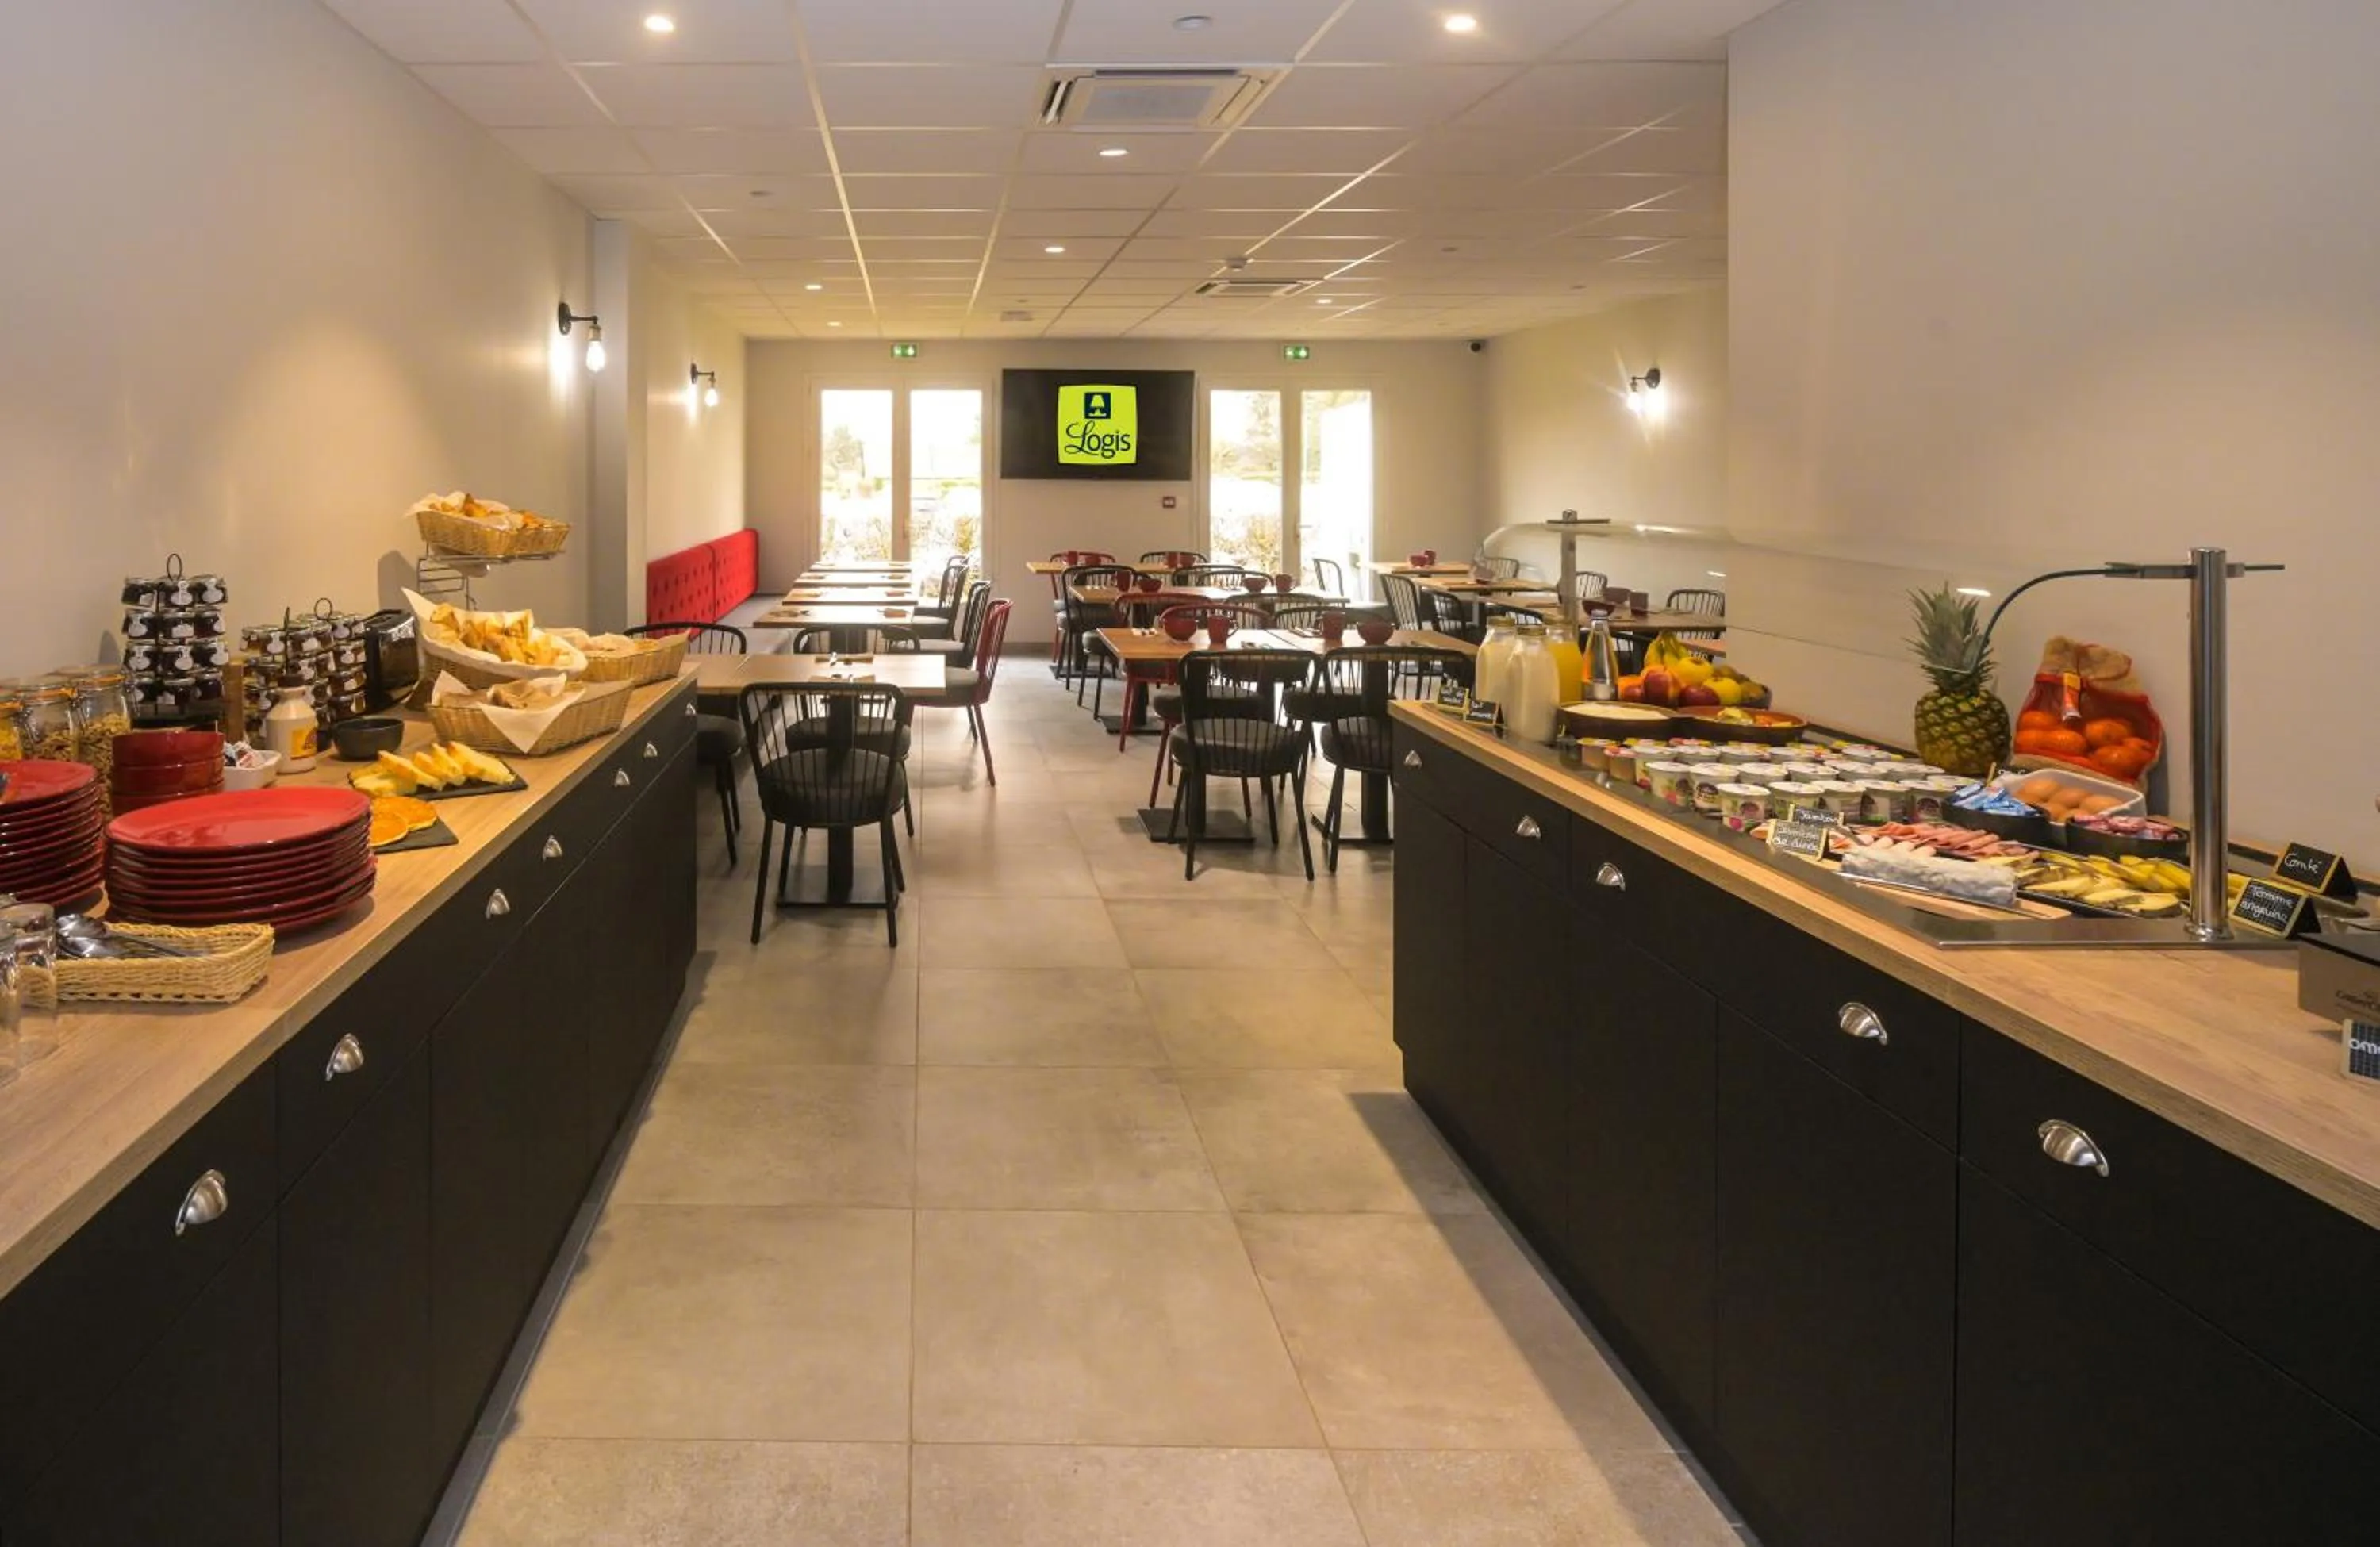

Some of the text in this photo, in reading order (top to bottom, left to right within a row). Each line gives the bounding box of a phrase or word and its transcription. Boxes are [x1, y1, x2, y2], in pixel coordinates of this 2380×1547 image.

[1064, 420, 1130, 459] Logis
[2284, 852, 2322, 873] Comté
[2249, 885, 2293, 908] Tomme
